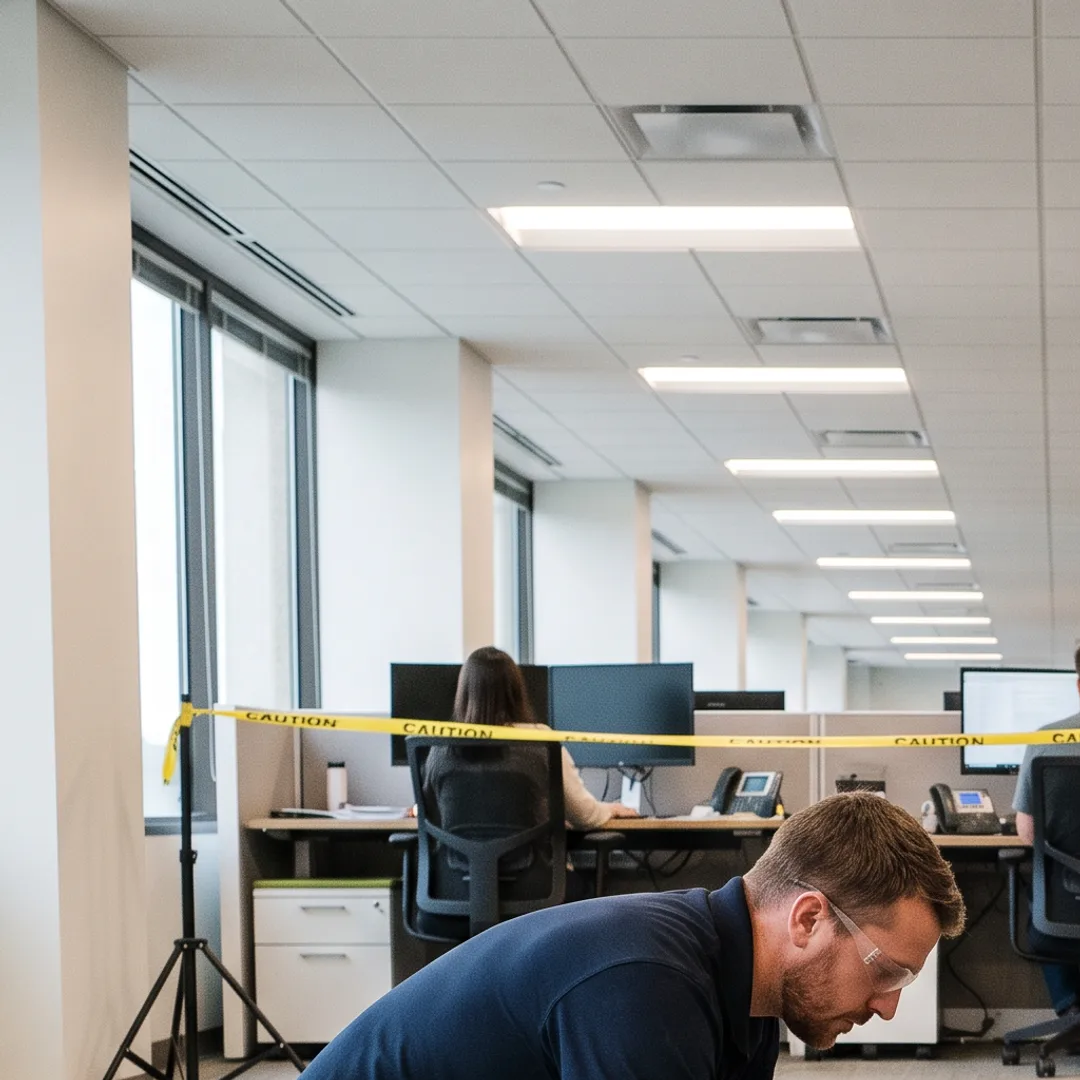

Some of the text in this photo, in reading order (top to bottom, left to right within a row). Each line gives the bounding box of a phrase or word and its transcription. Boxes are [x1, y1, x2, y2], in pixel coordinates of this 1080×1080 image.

[246, 712, 337, 728] CAUTION
[403, 723, 494, 739] CAUTION
[895, 737, 985, 746] CAUTION
